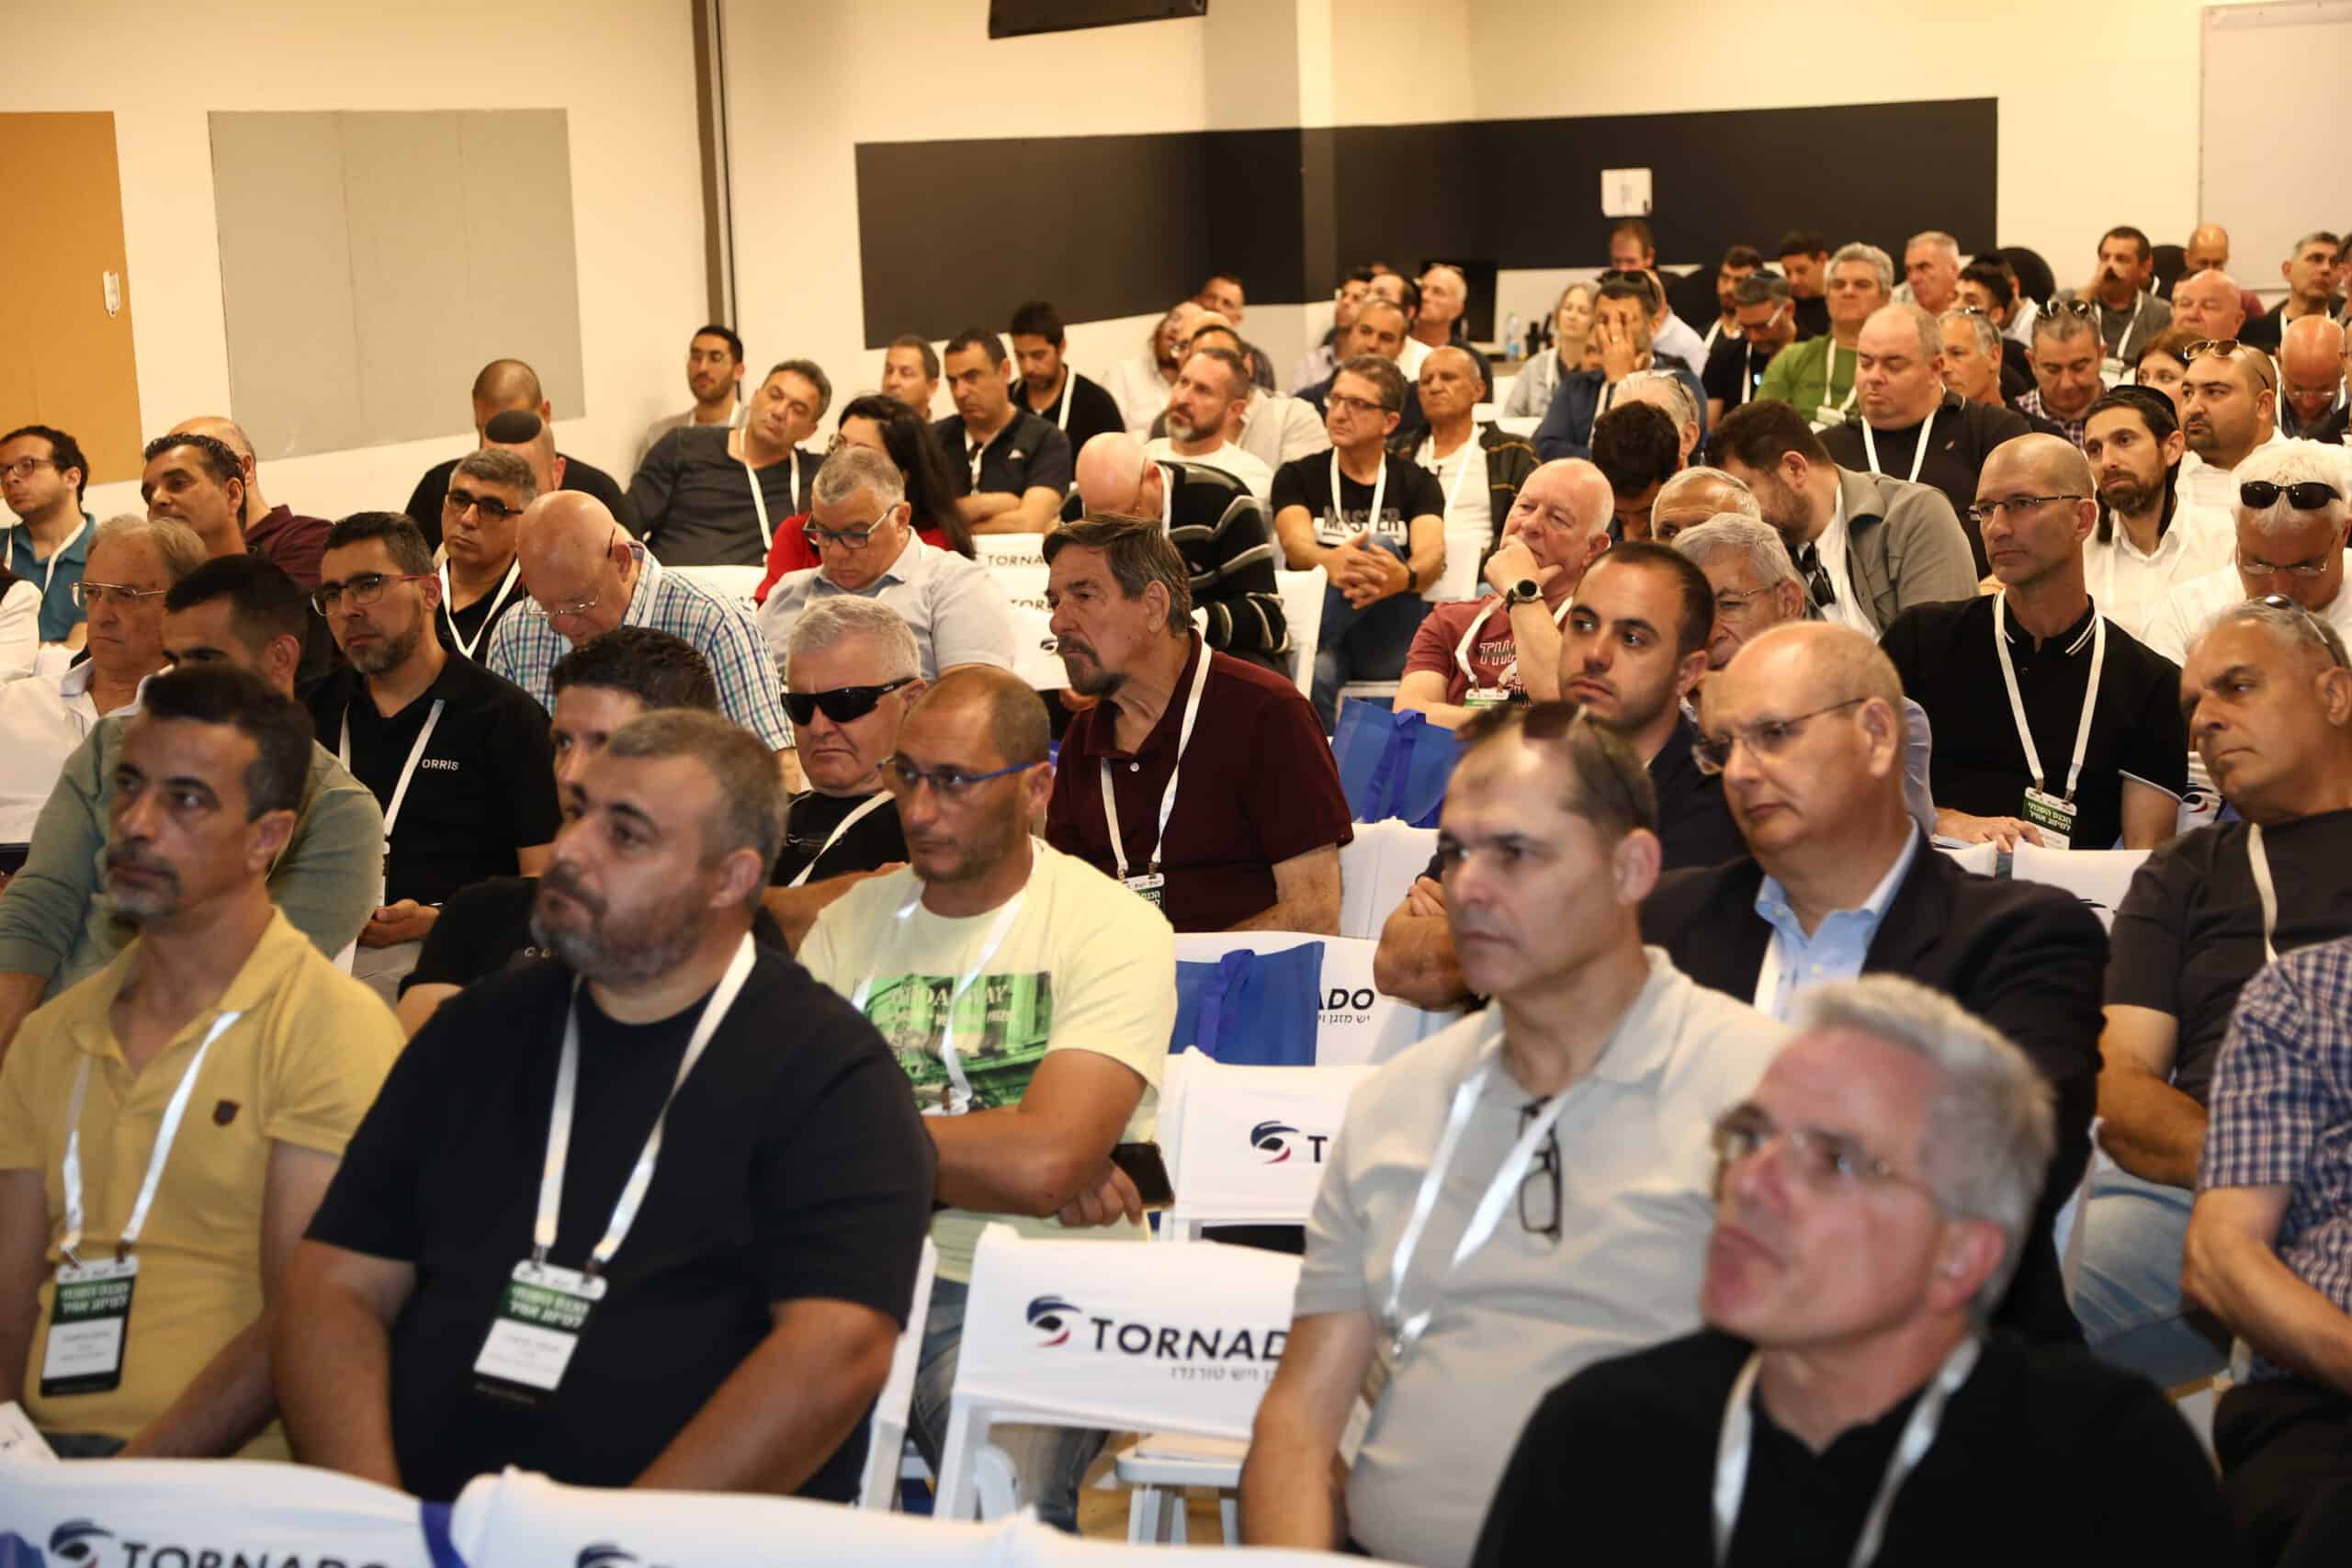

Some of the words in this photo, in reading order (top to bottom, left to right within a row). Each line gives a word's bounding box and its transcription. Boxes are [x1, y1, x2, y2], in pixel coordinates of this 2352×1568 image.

[1323, 505, 1401, 533] MASER
[988, 554, 1045, 566] TORNA
[1091, 1317, 1291, 1361] TORNAD
